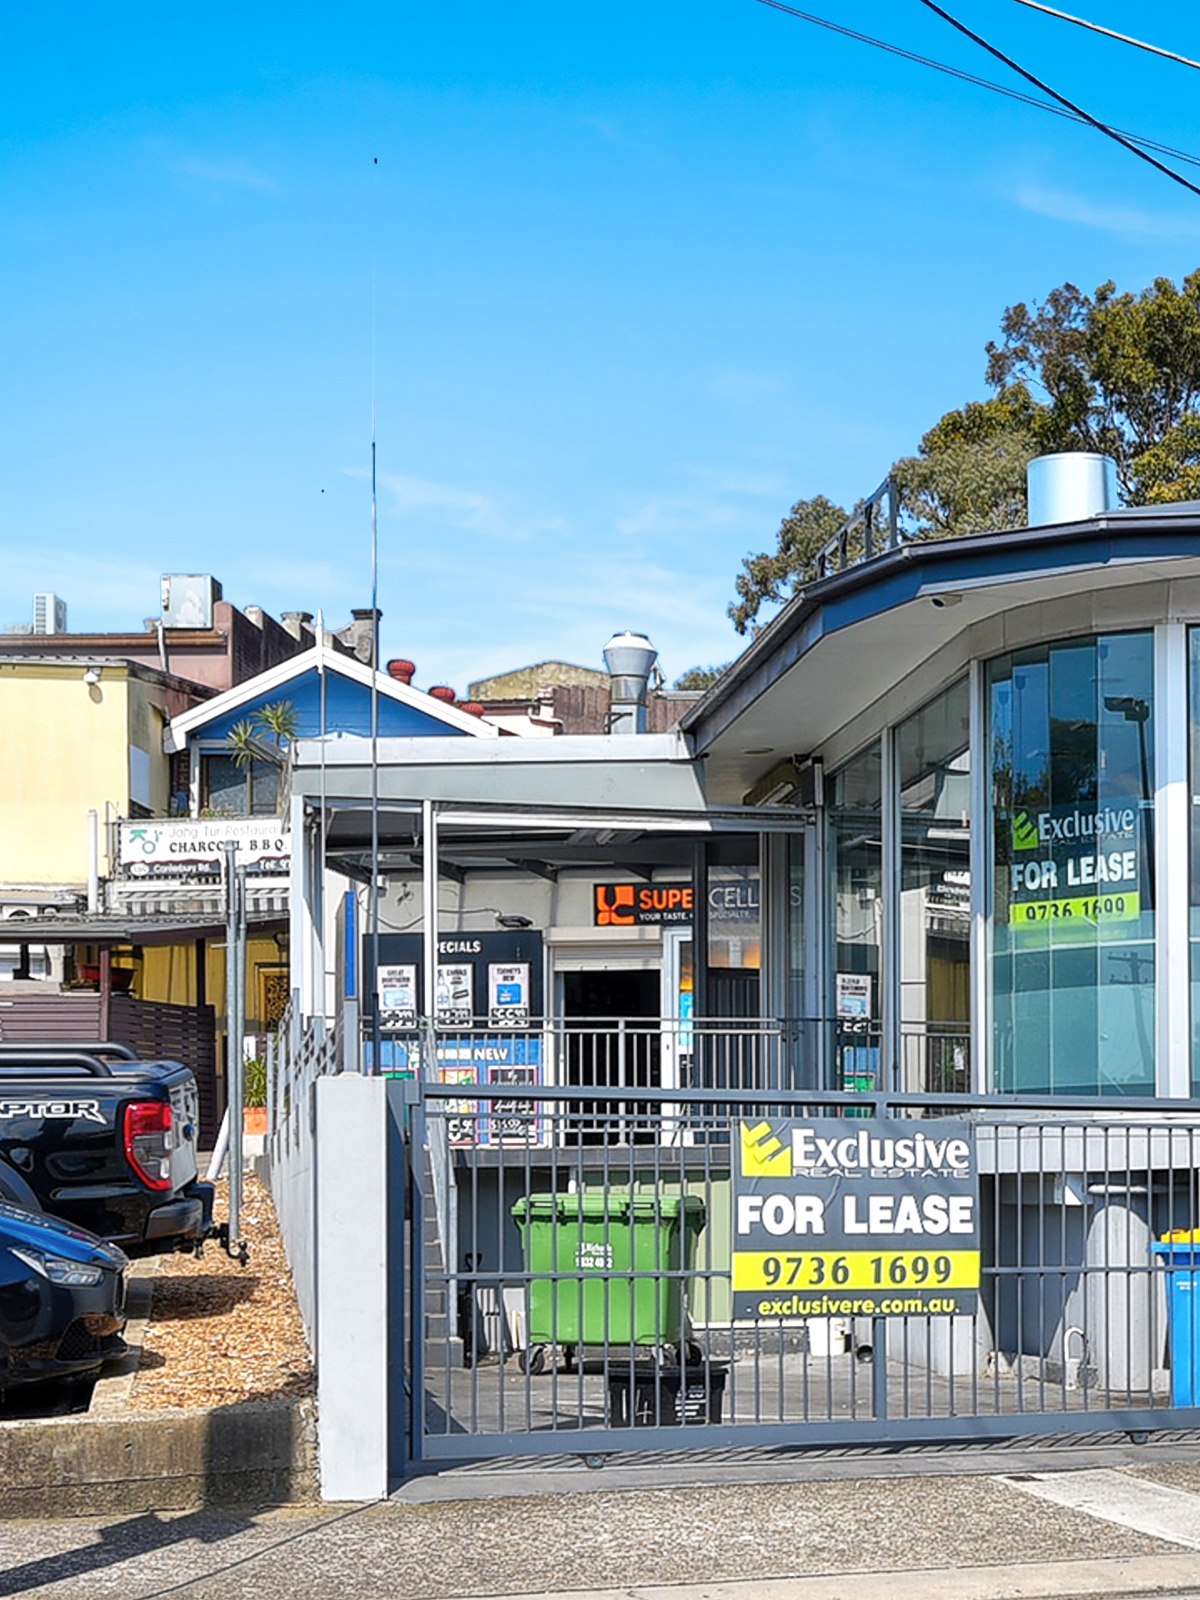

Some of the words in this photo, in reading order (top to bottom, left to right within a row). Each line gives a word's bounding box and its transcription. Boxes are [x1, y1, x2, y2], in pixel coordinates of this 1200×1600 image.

[225, 824, 284, 838] Restauran
[1038, 808, 1134, 841] Exclusive
[1011, 860, 1058, 892] FOR
[1067, 850, 1137, 887] LEASE
[639, 889, 694, 909] SUPE
[473, 1048, 508, 1061] NEW
[791, 1128, 970, 1169] Exclusive
[791, 1168, 862, 1177] REAL
[870, 1168, 970, 1178] ESTATE
[737, 1195, 825, 1234] FOR
[844, 1196, 974, 1234] LEASE
[762, 1257, 850, 1286] 9736
[870, 1256, 951, 1284] 1699
[758, 1296, 956, 1316] exclusivere.com.au
